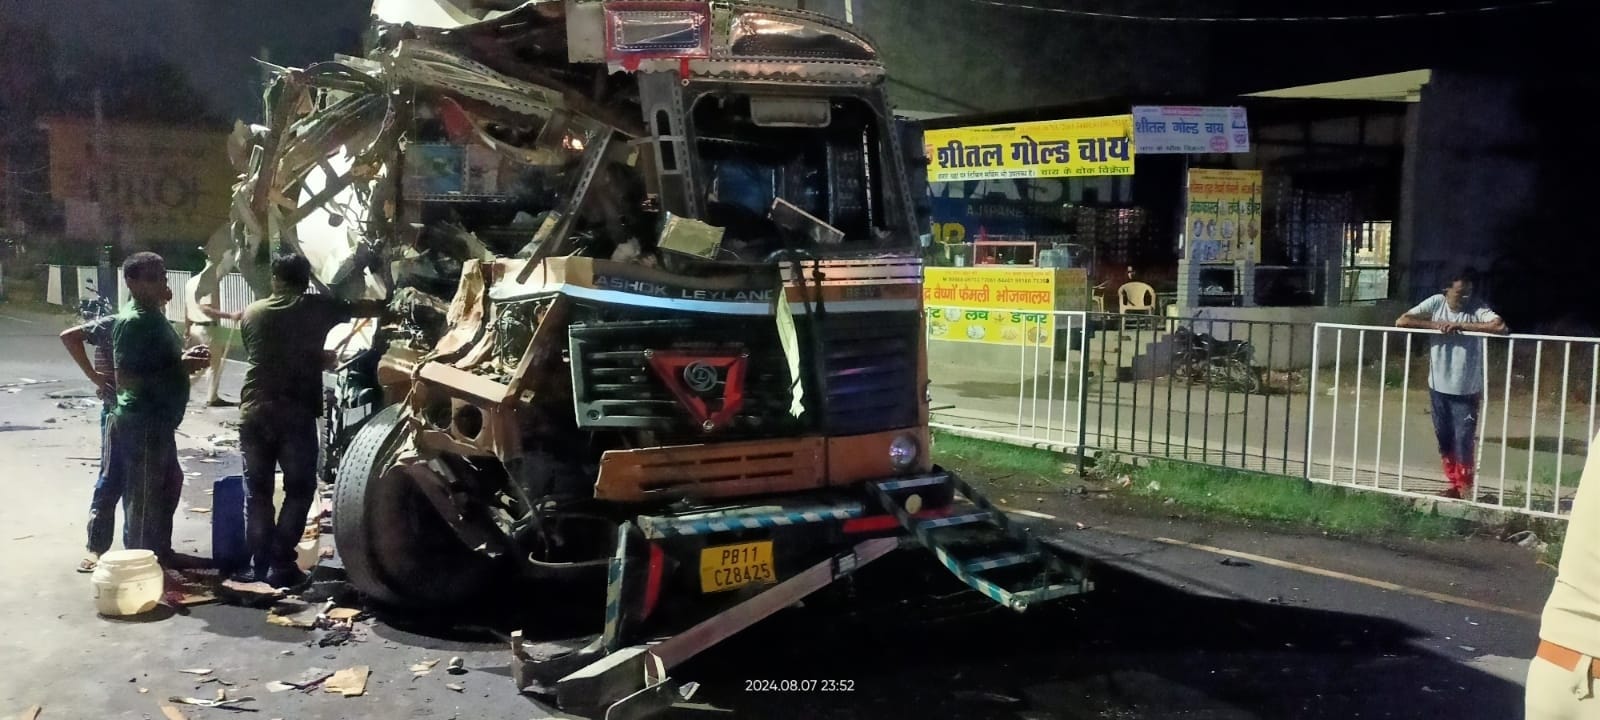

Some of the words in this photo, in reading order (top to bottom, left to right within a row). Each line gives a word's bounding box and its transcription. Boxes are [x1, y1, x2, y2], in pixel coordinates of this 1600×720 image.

[1135, 117, 1166, 133] शीतल
[1171, 117, 1199, 134] गोल्ड
[1204, 122, 1225, 134] चाय
[937, 139, 1005, 168] शीतल
[1010, 135, 1070, 165] गोल्ड
[1077, 135, 1131, 162] चाय
[1041, 168, 1059, 176] चाय
[1063, 167, 1071, 175] के
[1076, 166, 1096, 174] थोक
[595, 275, 669, 297] ASHOK
[681, 288, 774, 301] LEYLAND
[996, 286, 1050, 305] भोजनालय
[721, 546, 758, 566] PB11
[714, 563, 771, 587] CZ8425
